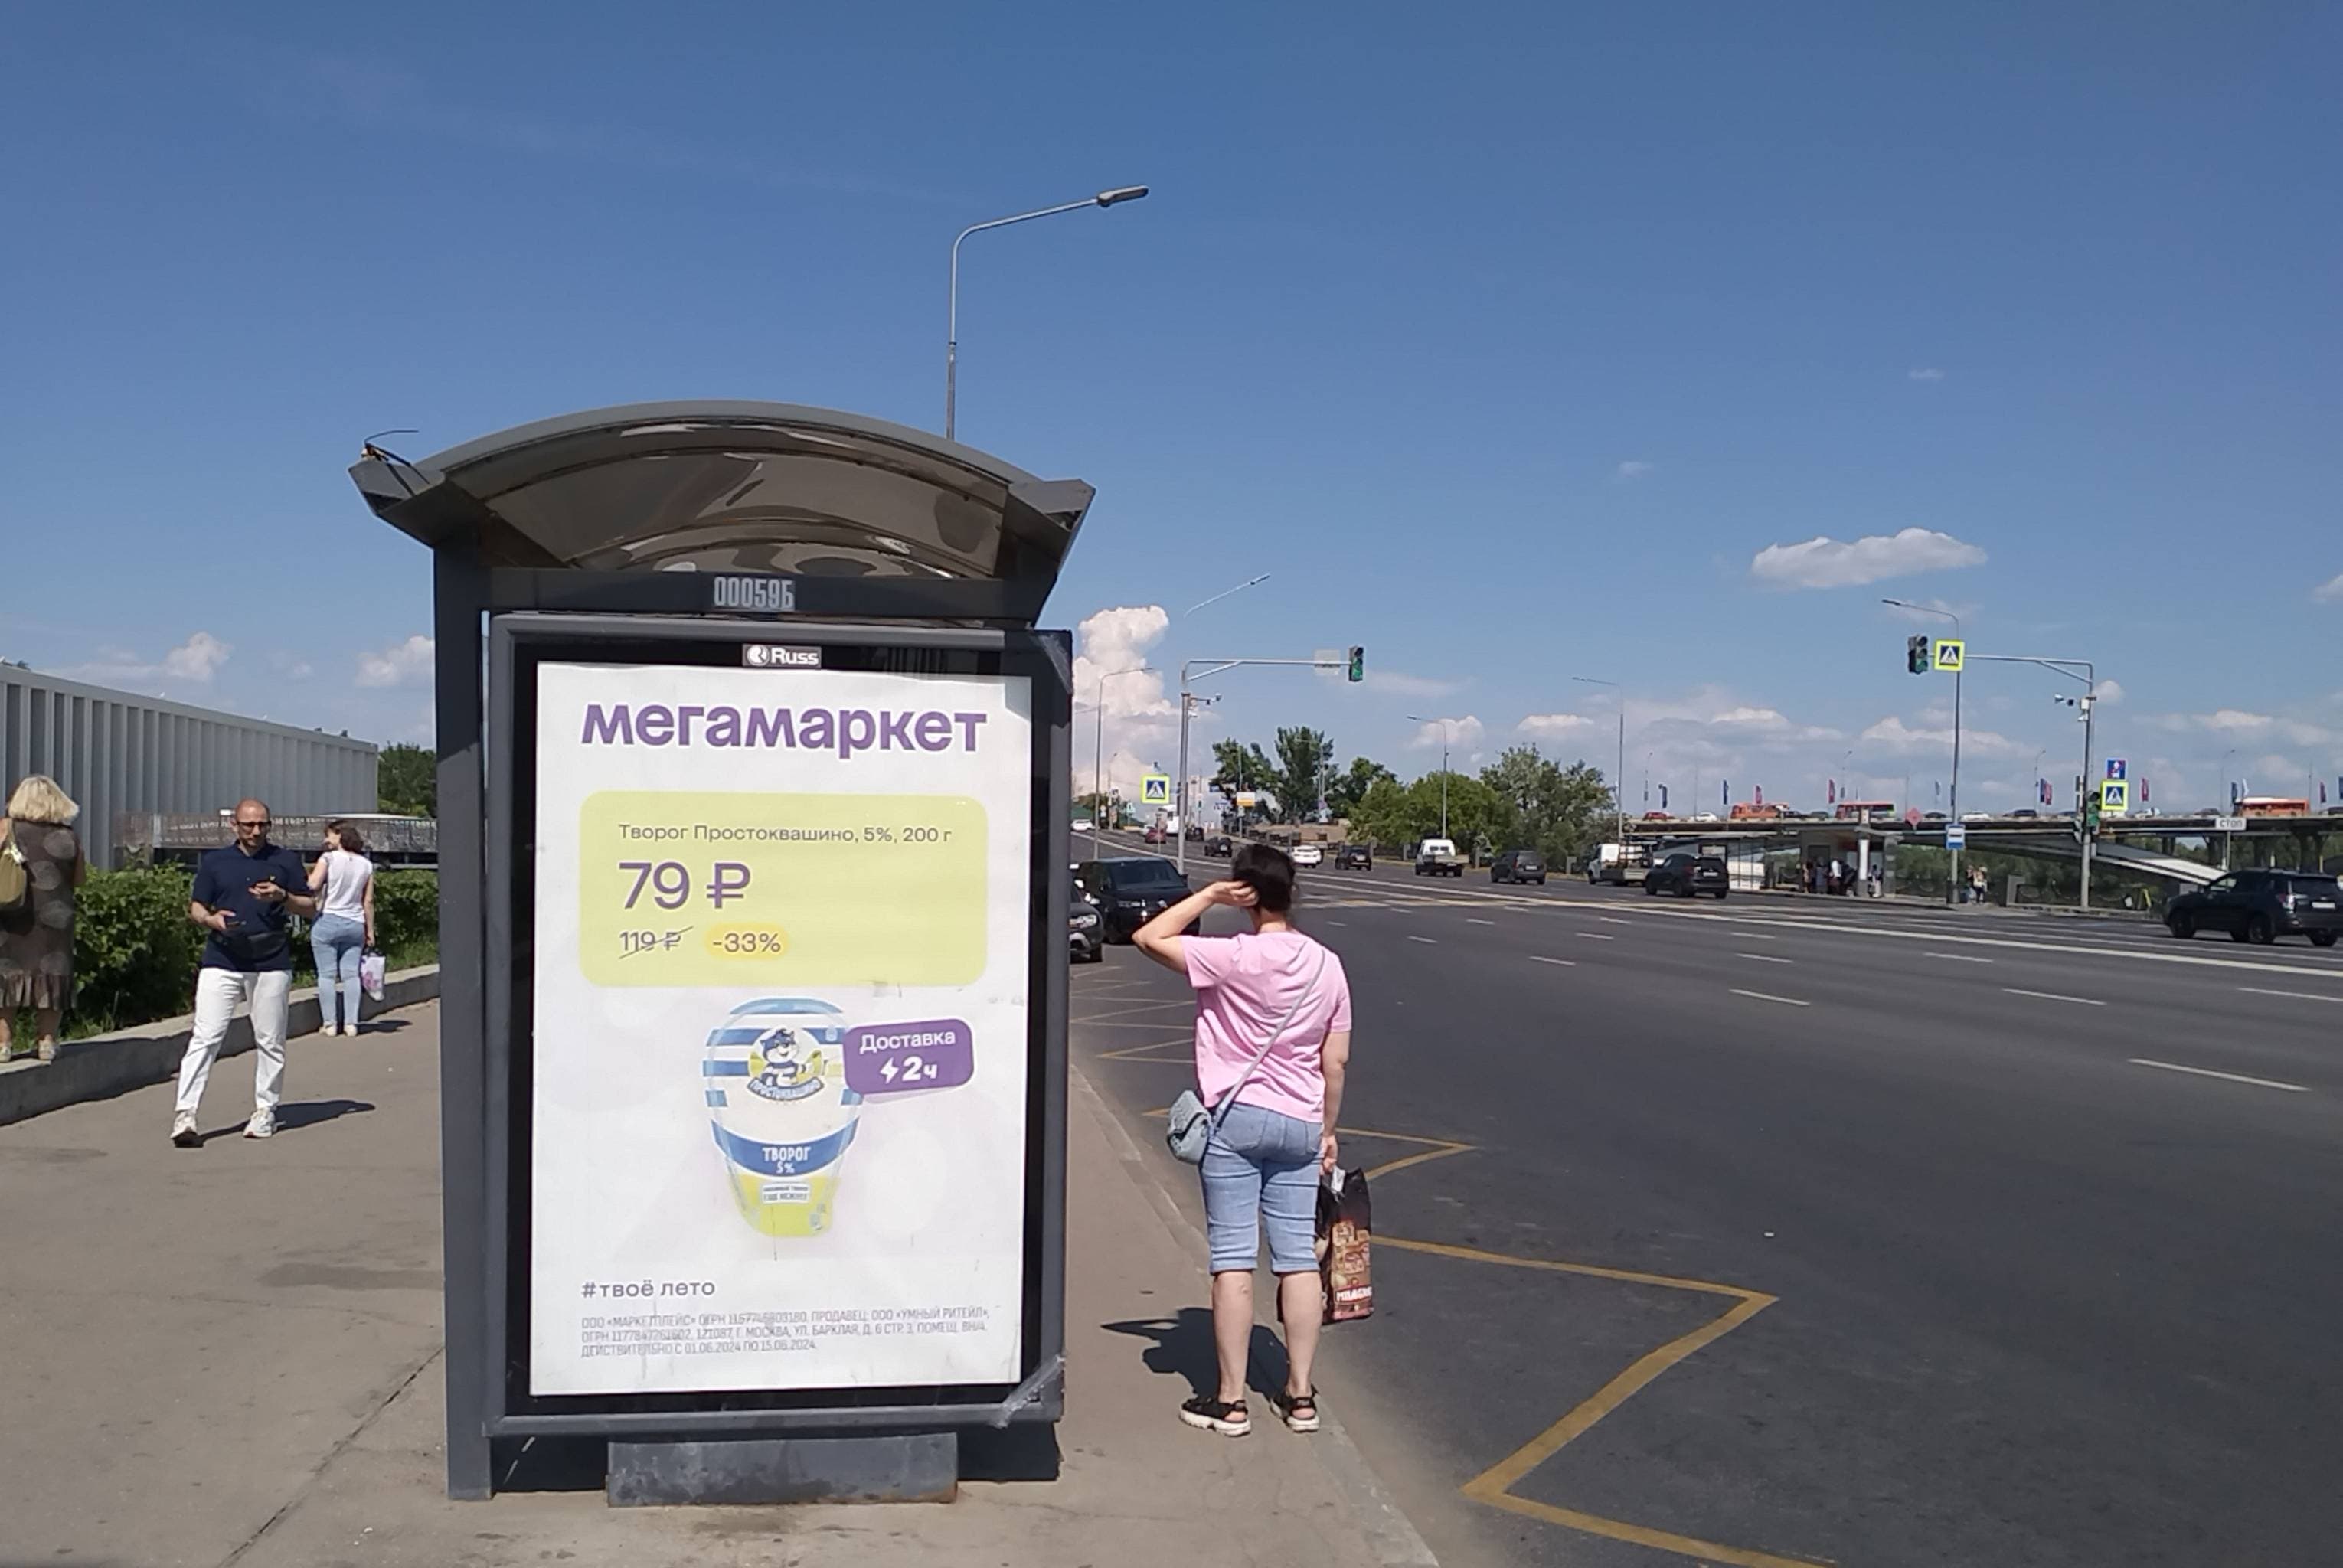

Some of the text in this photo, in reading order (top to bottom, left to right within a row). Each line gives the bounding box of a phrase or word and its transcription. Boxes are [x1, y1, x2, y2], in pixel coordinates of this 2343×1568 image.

[771, 647, 819, 665] Russ
[580, 704, 987, 760] мегамаркет
[619, 825, 953, 843] Творог Простоквашино, 5%, 200 г
[619, 861, 691, 910] 79
[619, 932, 656, 952] 119
[712, 933, 781, 952] -33%
[859, 1031, 956, 1054] Доставка
[902, 1056, 937, 1081] 2ч
[762, 1146, 811, 1161] ТВОРОГ
[582, 1279, 716, 1298] #твоё лето
[582, 1317, 604, 1328] ООО
[698, 1314, 725, 1325] ОГРН
[871, 1309, 893, 1321] ООО
[896, 1306, 940, 1320] «УМНЫЙ
[582, 1331, 609, 1342] ОГРН
[746, 1325, 792, 1339] МОСКВА,
[581, 1342, 673, 1357] ДЕЙСТВИТЕЛЬНО
[675, 1342, 682, 1354] С
[685, 1341, 741, 1354] 01.06.2024
[743, 1341, 758, 1353] ПО
